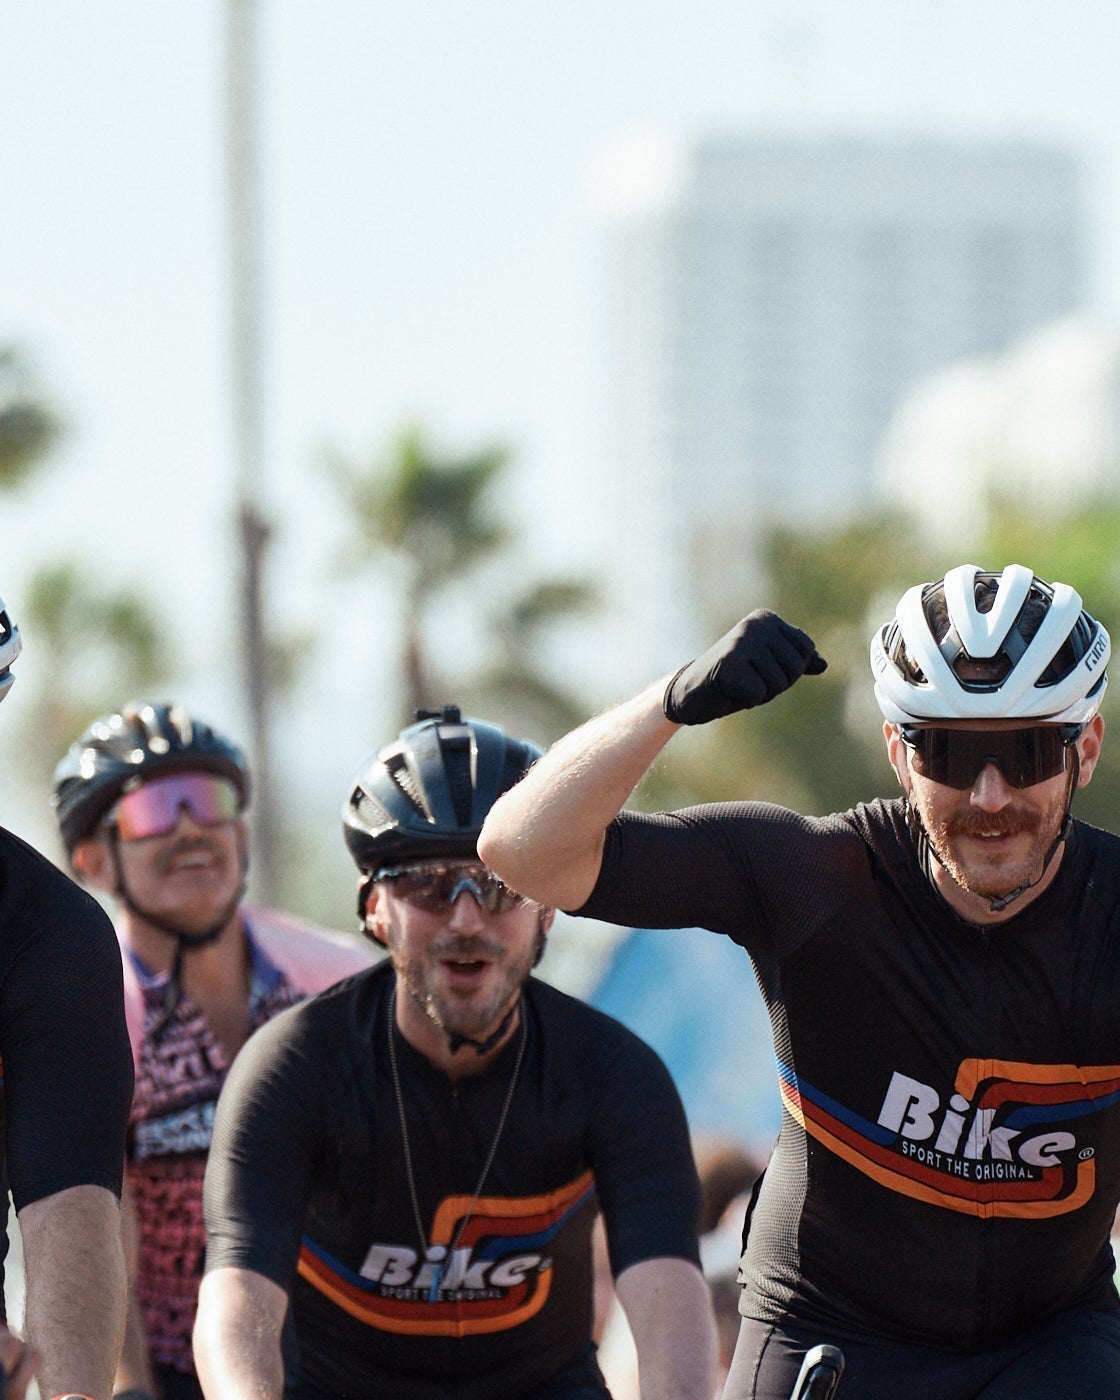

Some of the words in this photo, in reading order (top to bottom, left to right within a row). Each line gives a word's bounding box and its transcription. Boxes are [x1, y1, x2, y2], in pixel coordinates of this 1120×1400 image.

[877, 1071, 1076, 1168] Bike
[902, 1141, 941, 1168] SPORT
[946, 1158, 970, 1178] THE
[975, 1163, 1034, 1180] ORIGINAL
